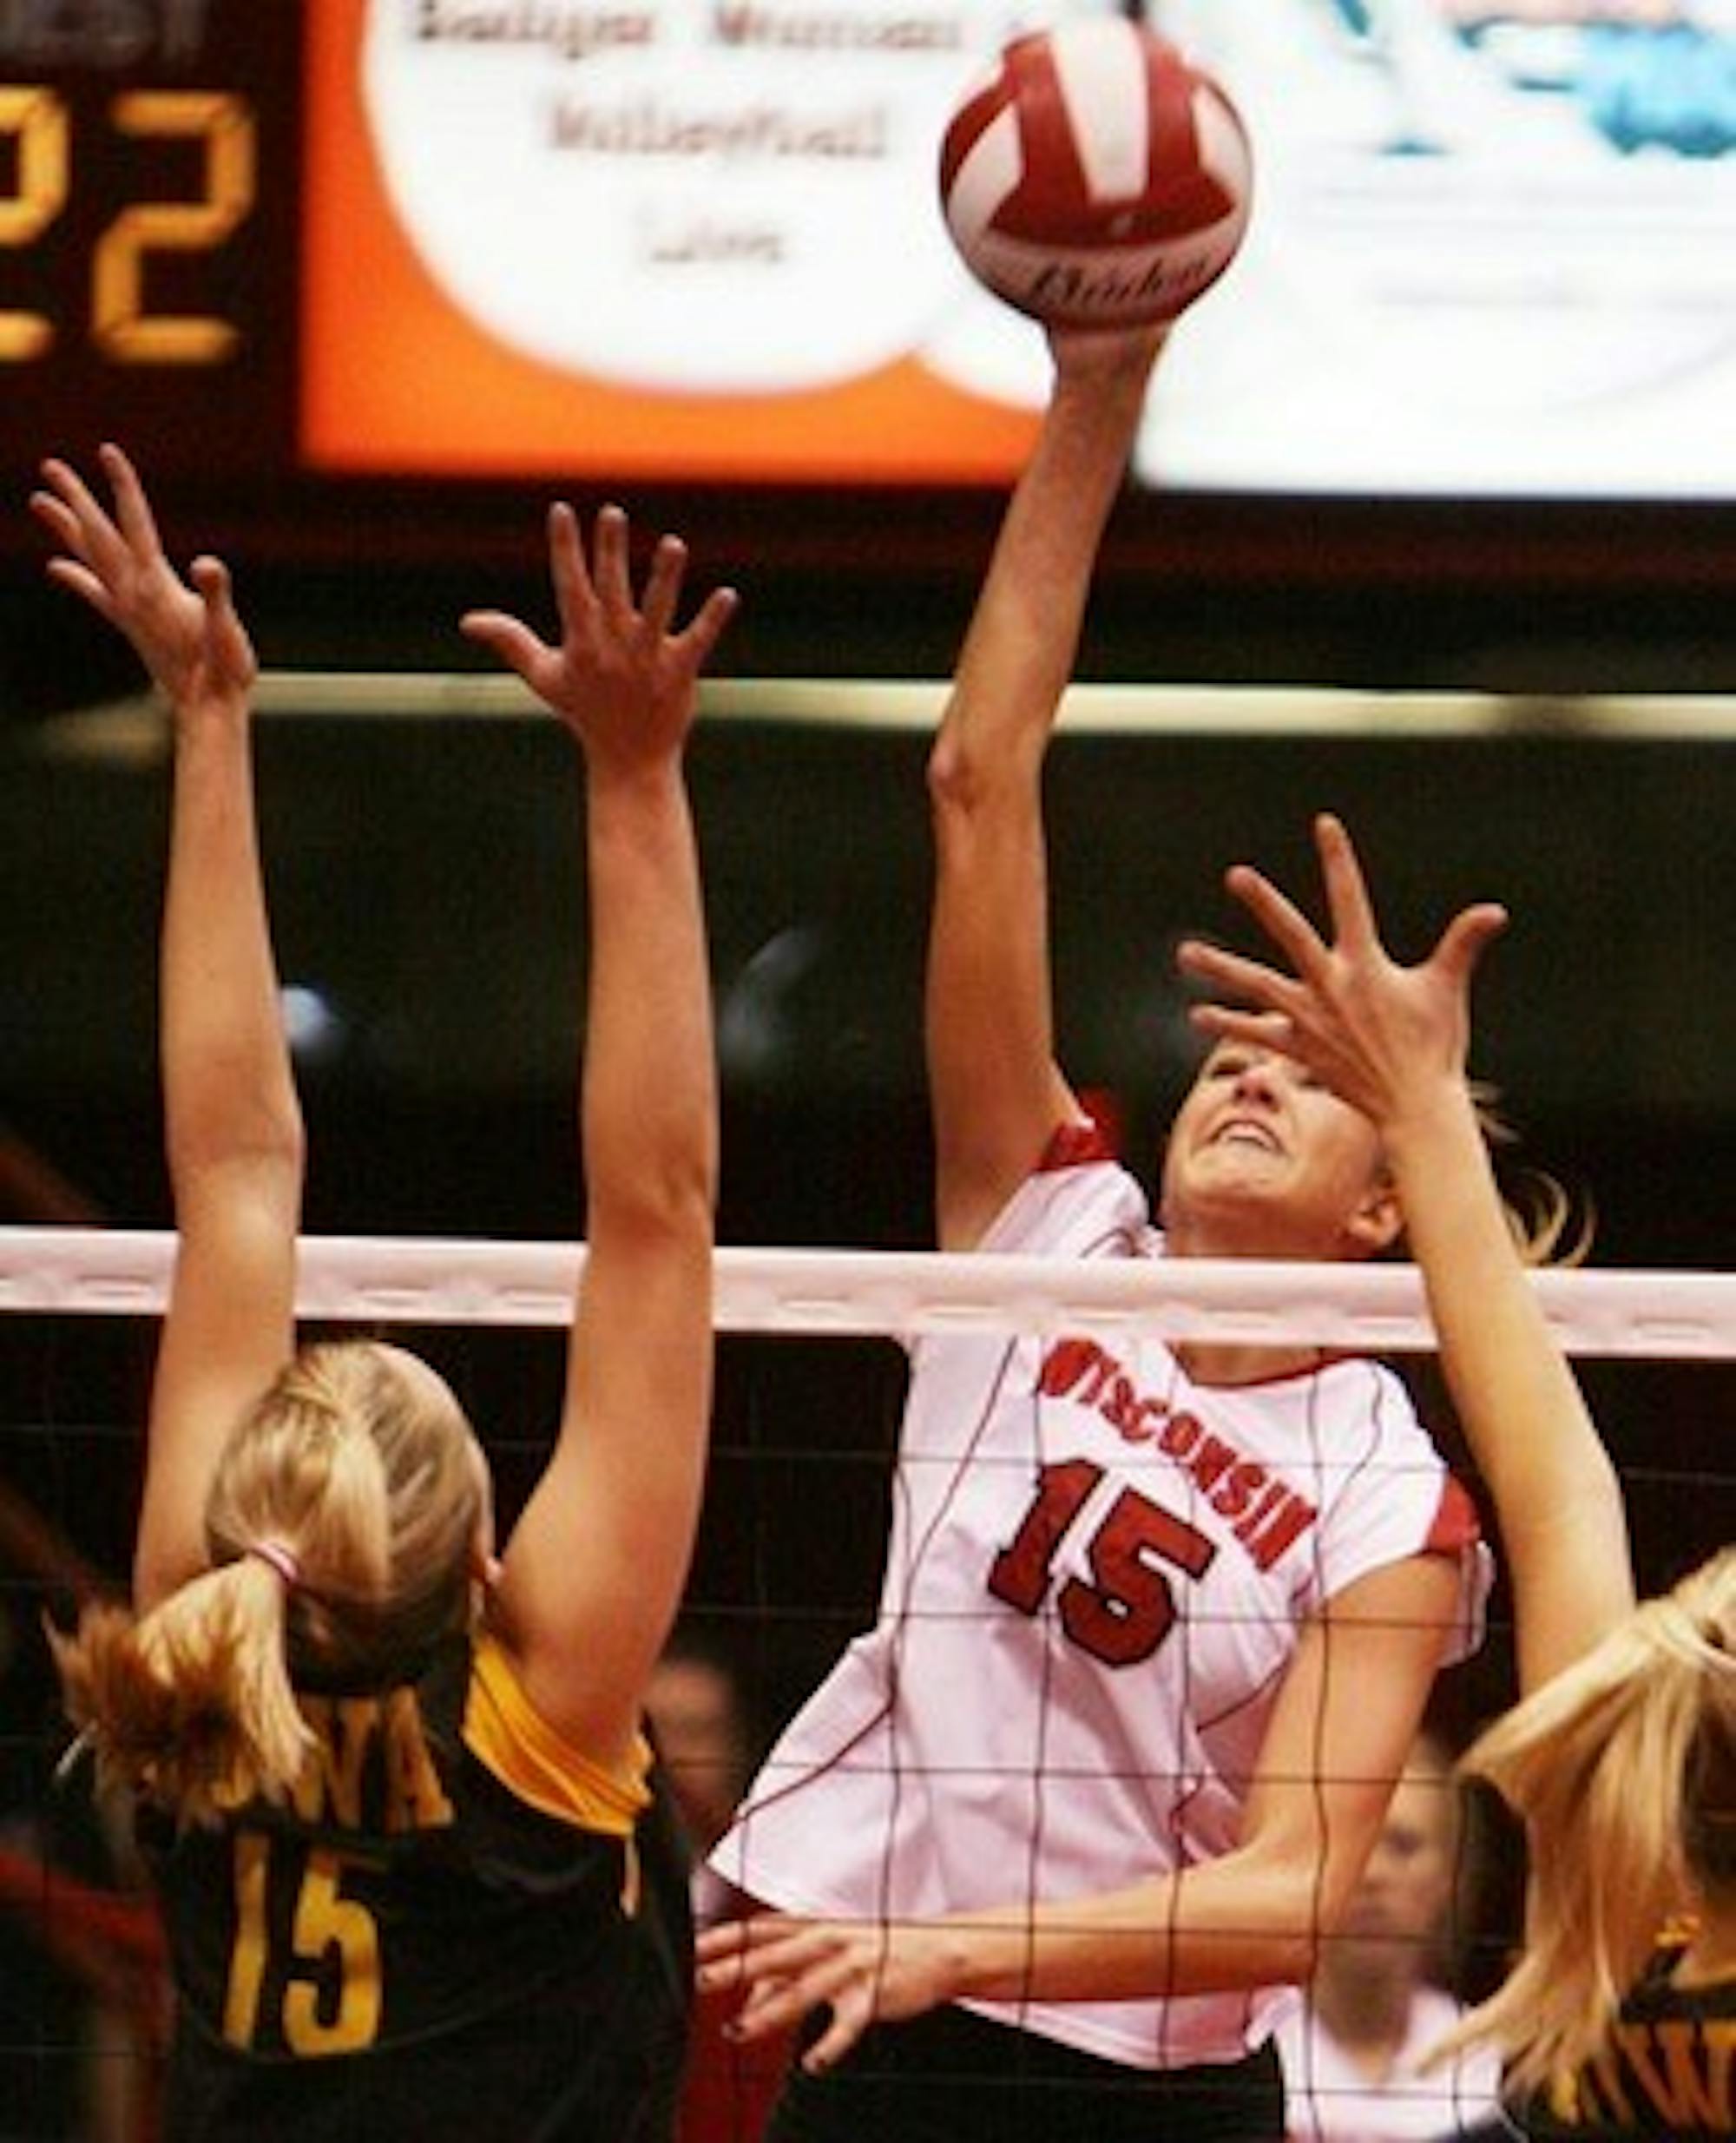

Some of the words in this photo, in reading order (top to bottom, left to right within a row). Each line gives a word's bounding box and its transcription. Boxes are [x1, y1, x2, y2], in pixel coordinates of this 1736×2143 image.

[987, 1458, 1219, 1669] 15
[1037, 1338, 1318, 1574] WISCONSIN
[222, 1831, 391, 2058] 15
